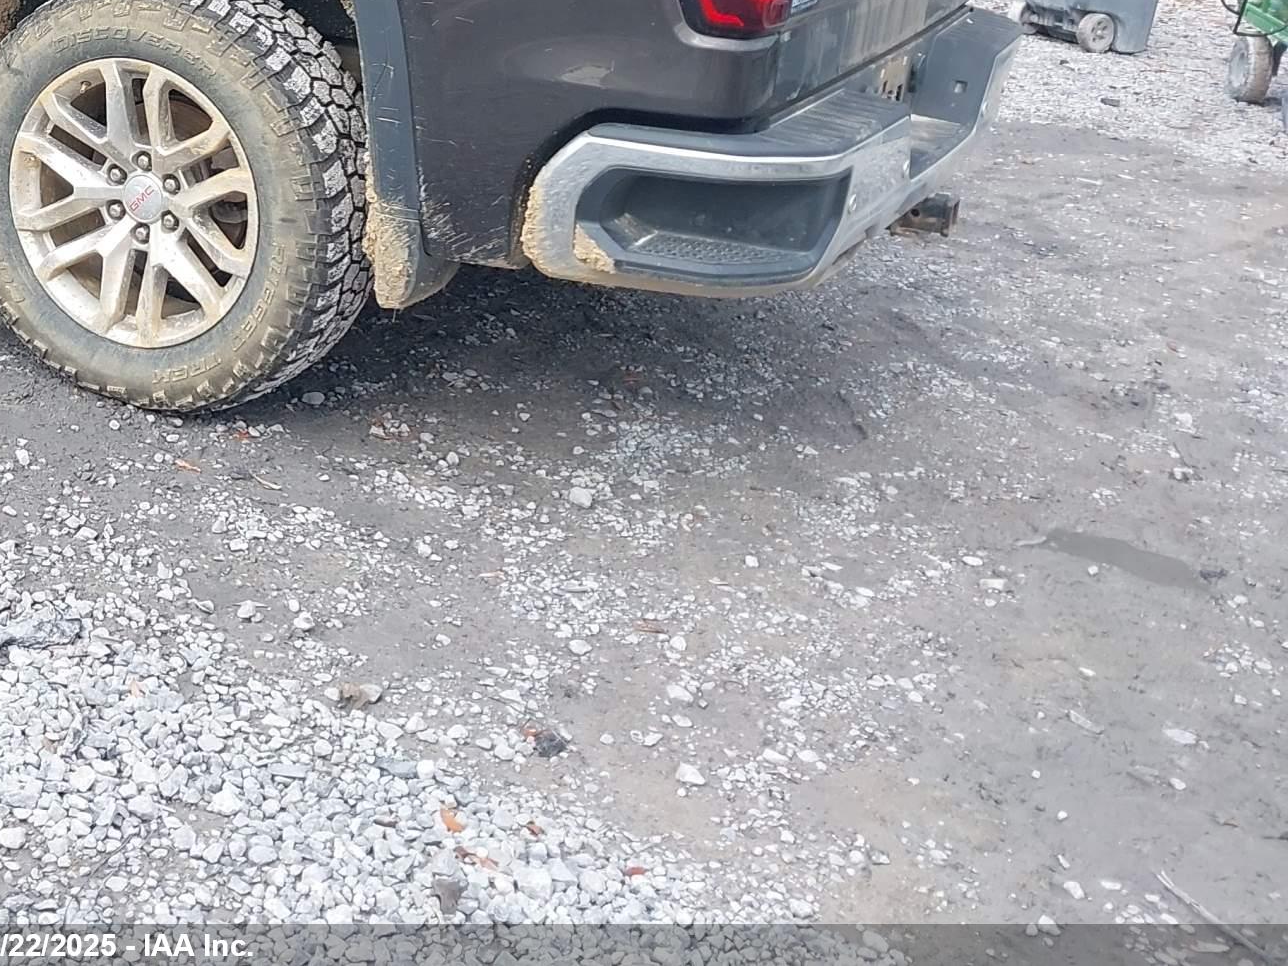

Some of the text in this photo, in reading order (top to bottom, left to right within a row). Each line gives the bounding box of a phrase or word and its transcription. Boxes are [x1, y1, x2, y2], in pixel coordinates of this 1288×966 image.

[51, 26, 217, 78] DISCOVERER
[129, 185, 155, 212] GMC
[152, 242, 287, 384] RUGGED TREK
